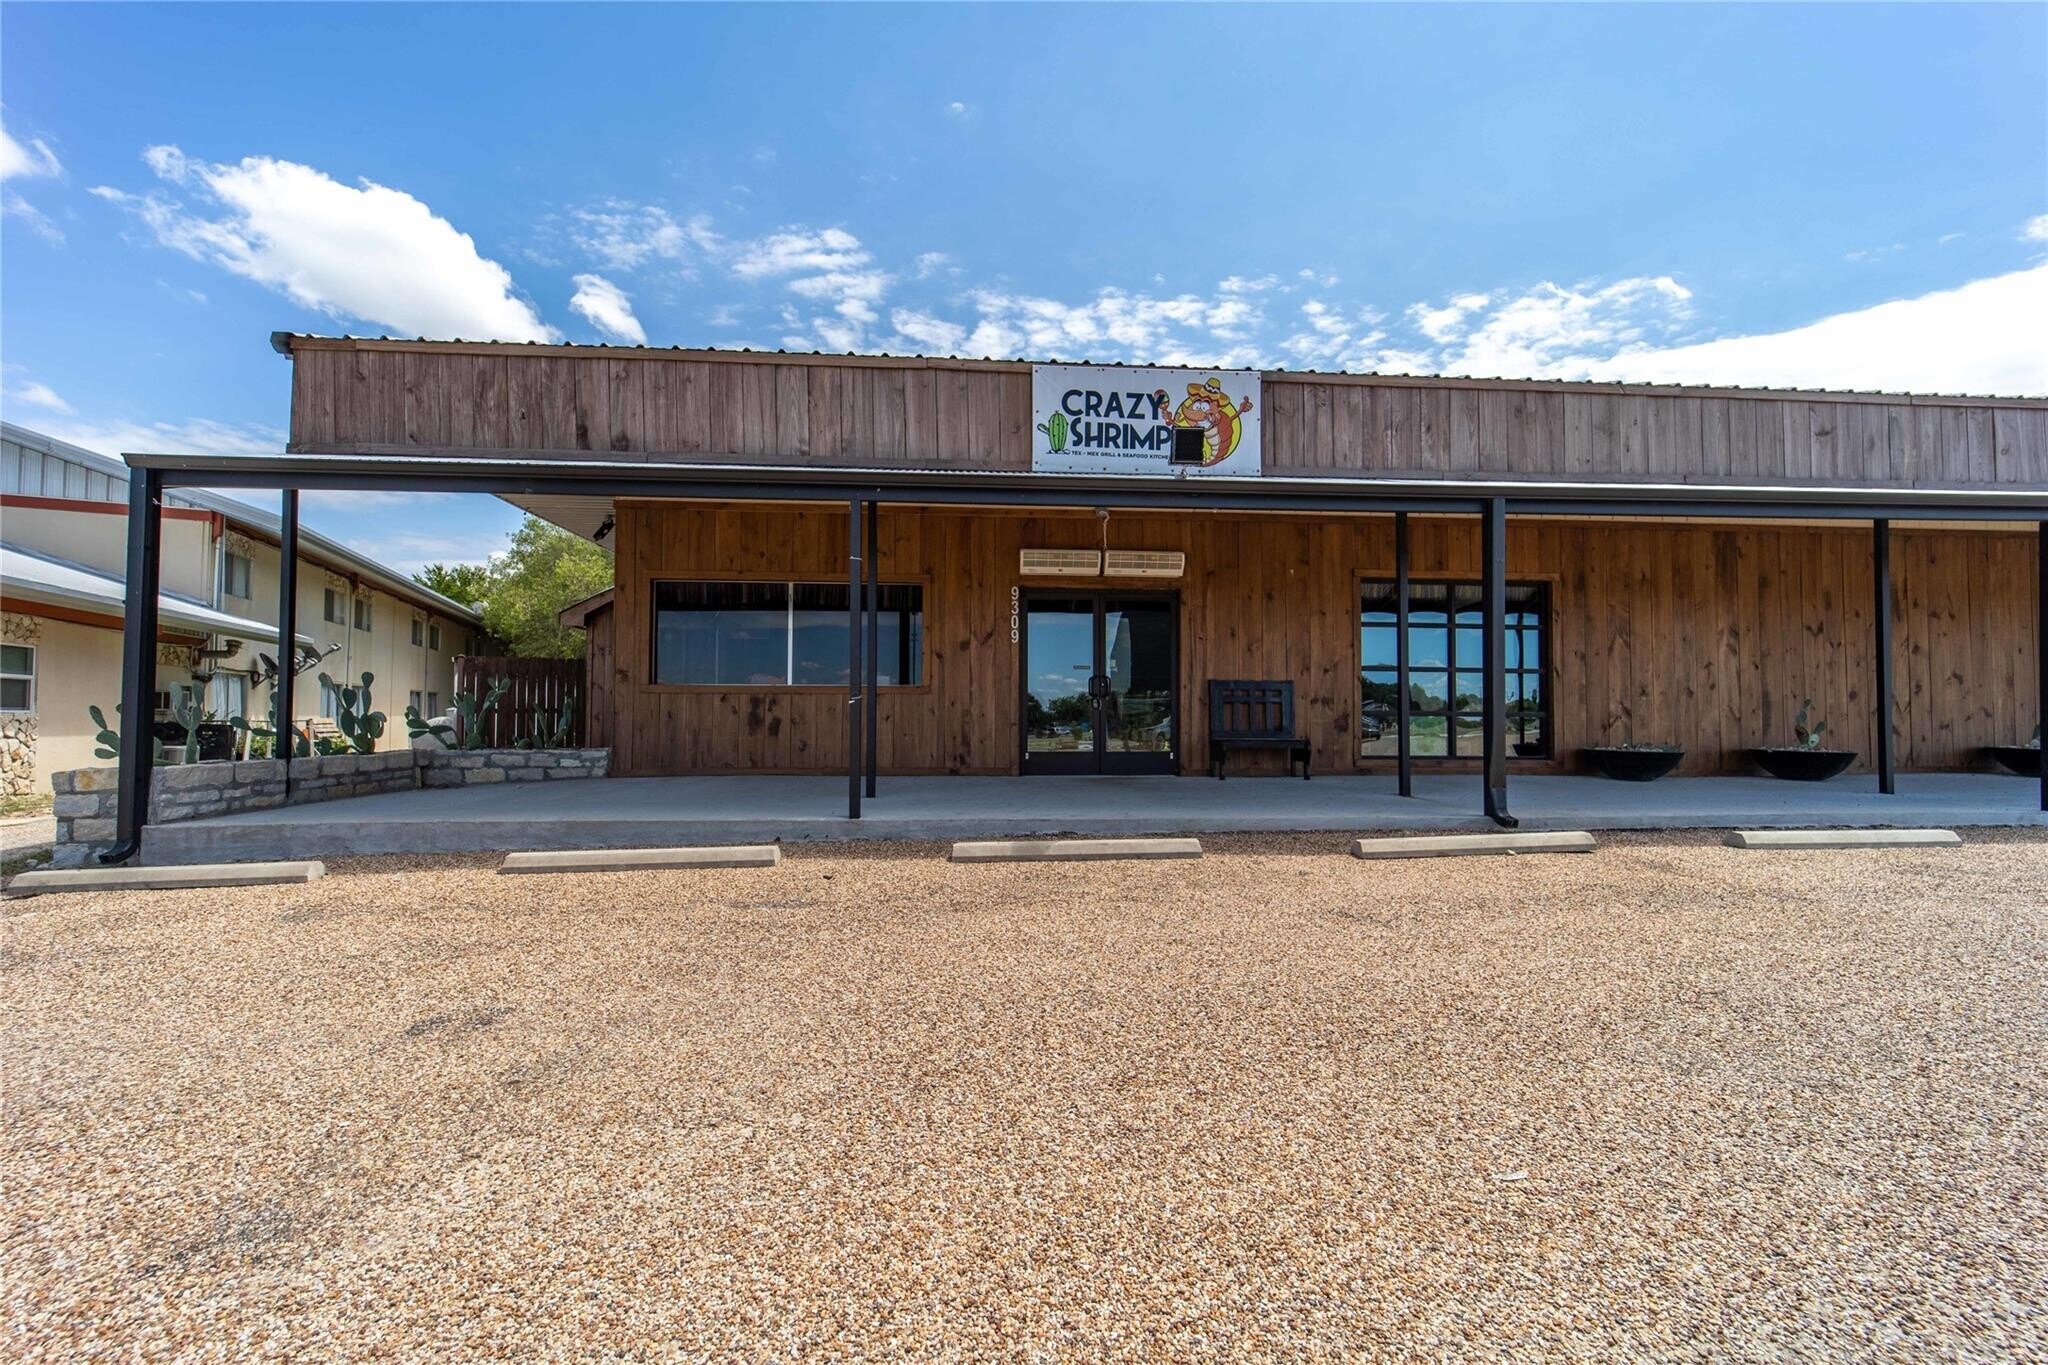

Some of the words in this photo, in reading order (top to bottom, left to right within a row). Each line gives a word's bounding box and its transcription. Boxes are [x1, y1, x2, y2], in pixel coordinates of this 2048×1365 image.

[1061, 389, 1165, 420] CRAZY
[1070, 417, 1172, 450] SHRIMP
[1011, 586, 1019, 643] 9309
